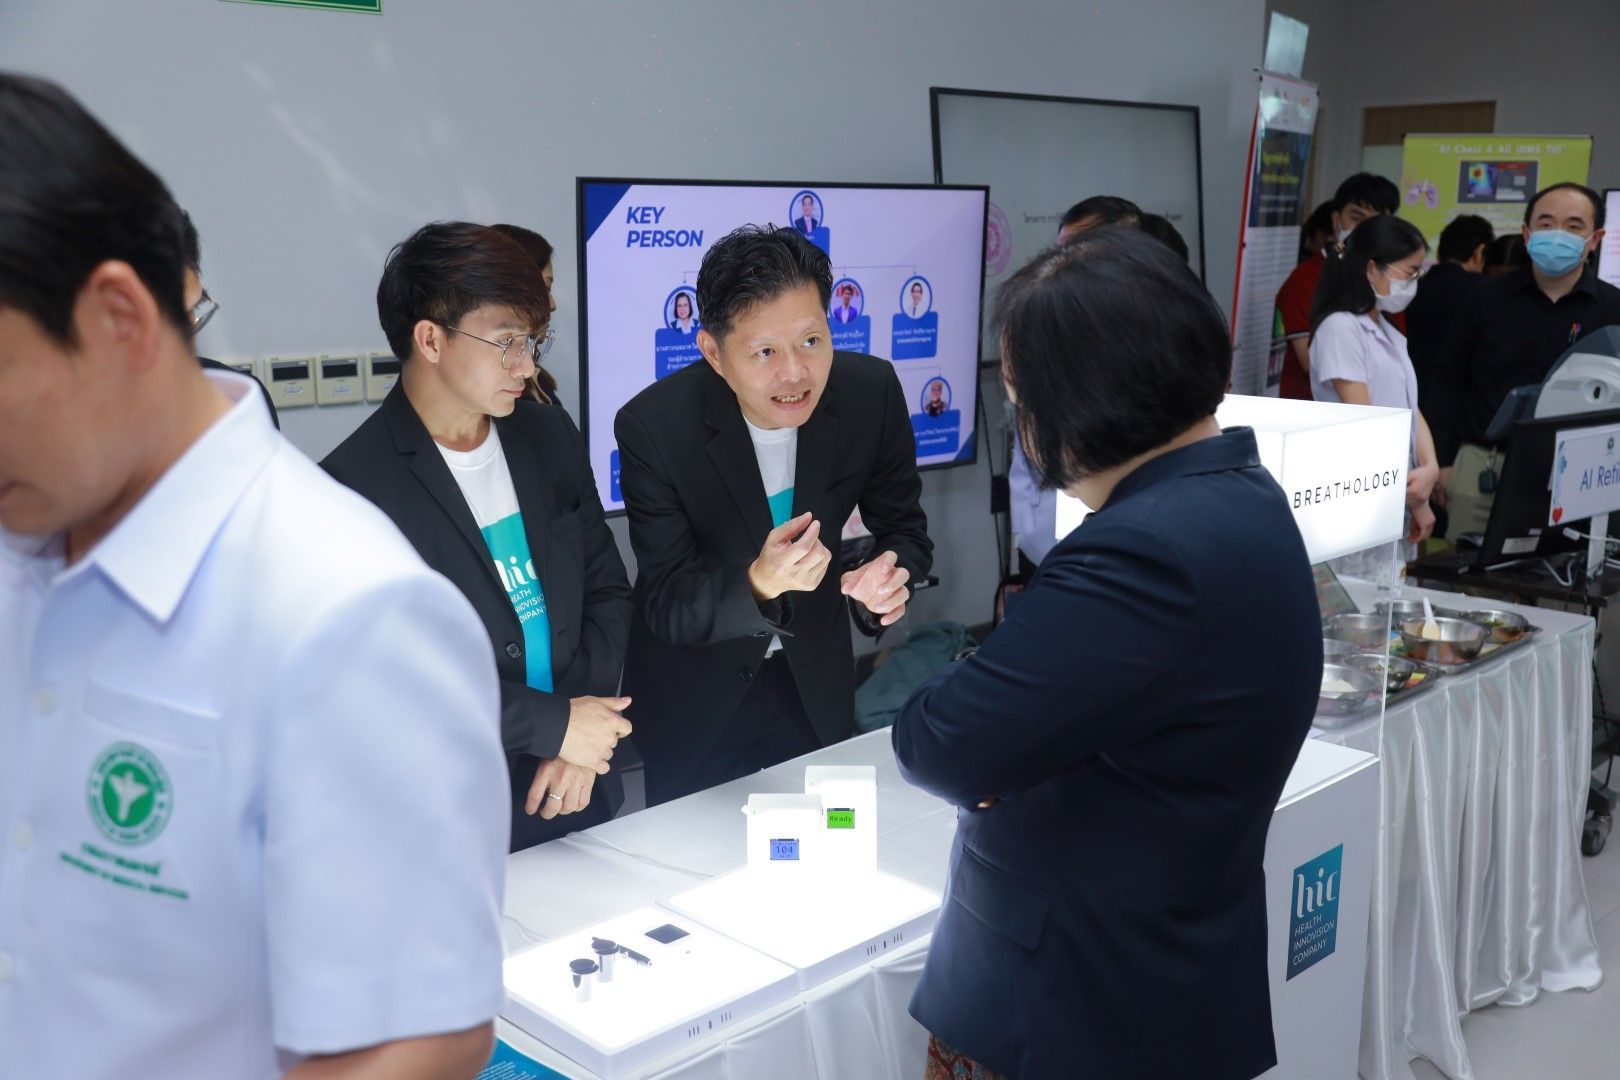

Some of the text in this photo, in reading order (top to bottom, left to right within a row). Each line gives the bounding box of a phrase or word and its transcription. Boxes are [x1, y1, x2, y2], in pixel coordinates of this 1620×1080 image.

[626, 206, 666, 225] KEY
[626, 229, 704, 248] PERSON
[1293, 468, 1399, 509] BREATHOLOGY
[1580, 467, 1594, 492] AI
[829, 815, 852, 824] Ready
[776, 845, 793, 854] 104
[1293, 920, 1335, 952] INNOVISION
[1294, 914, 1322, 937] HEALTH
[1292, 937, 1328, 966] COMPANY
